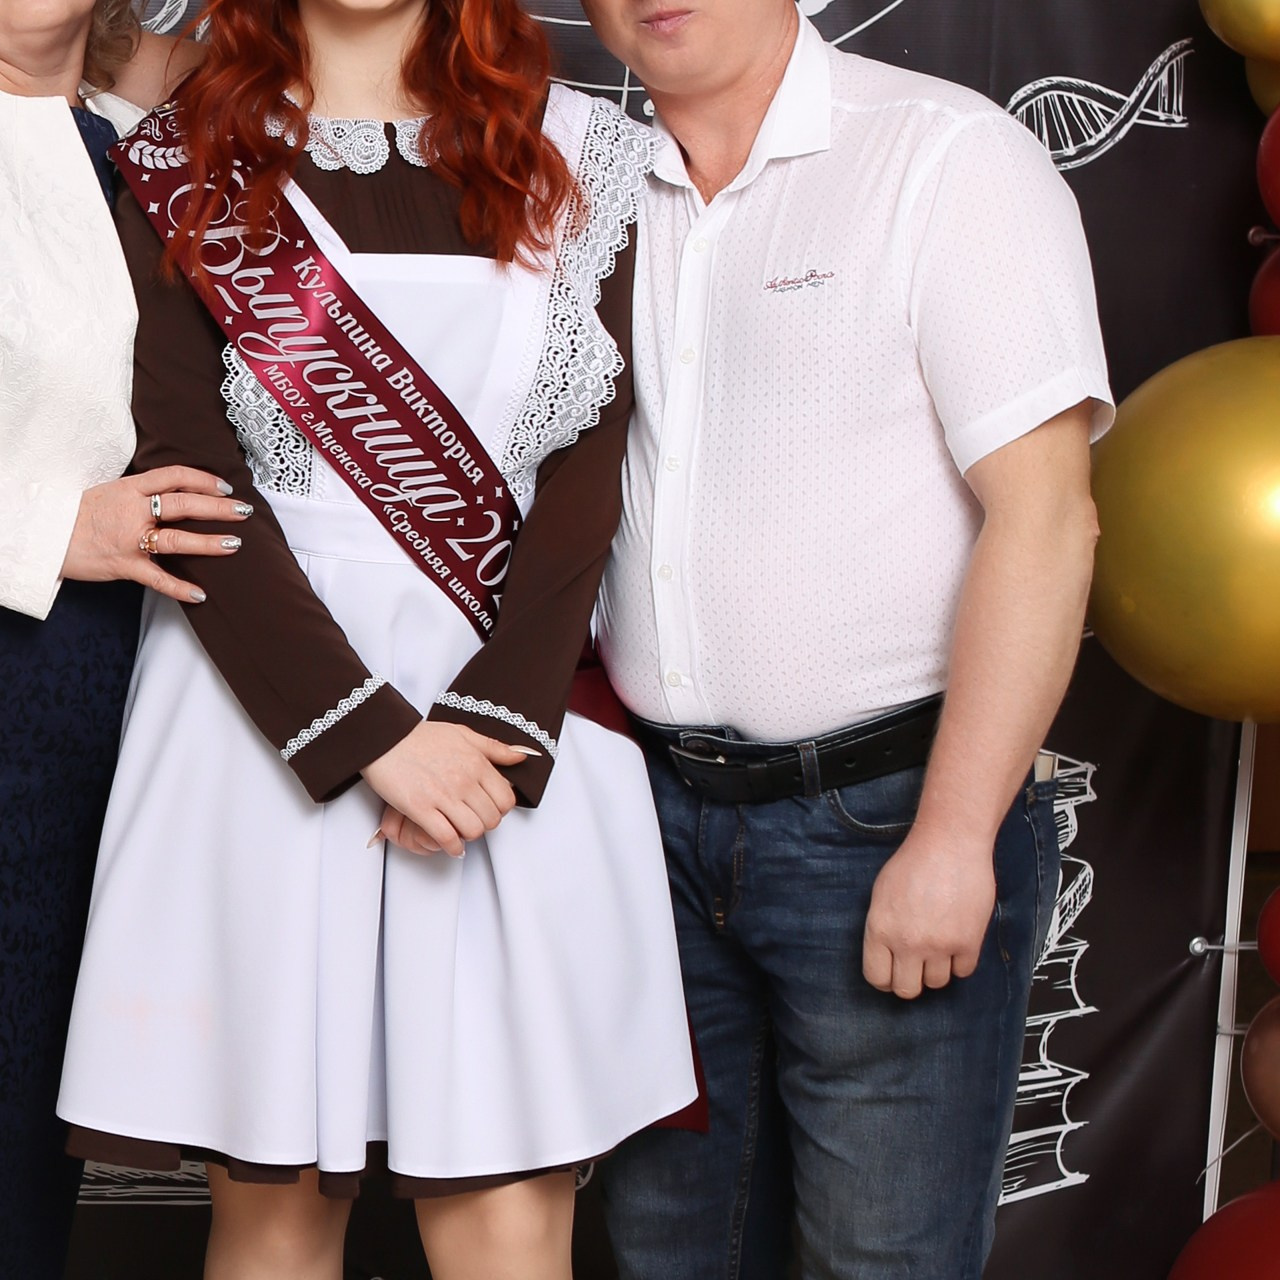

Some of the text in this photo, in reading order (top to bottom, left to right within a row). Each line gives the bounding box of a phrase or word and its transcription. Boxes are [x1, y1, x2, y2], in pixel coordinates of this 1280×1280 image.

[168, 167, 513, 609] Выпускница 20
[263, 363, 494, 631] МБОУ г.Мценска «Средняя школа
[292, 255, 485, 486] Кульпина Виктория
